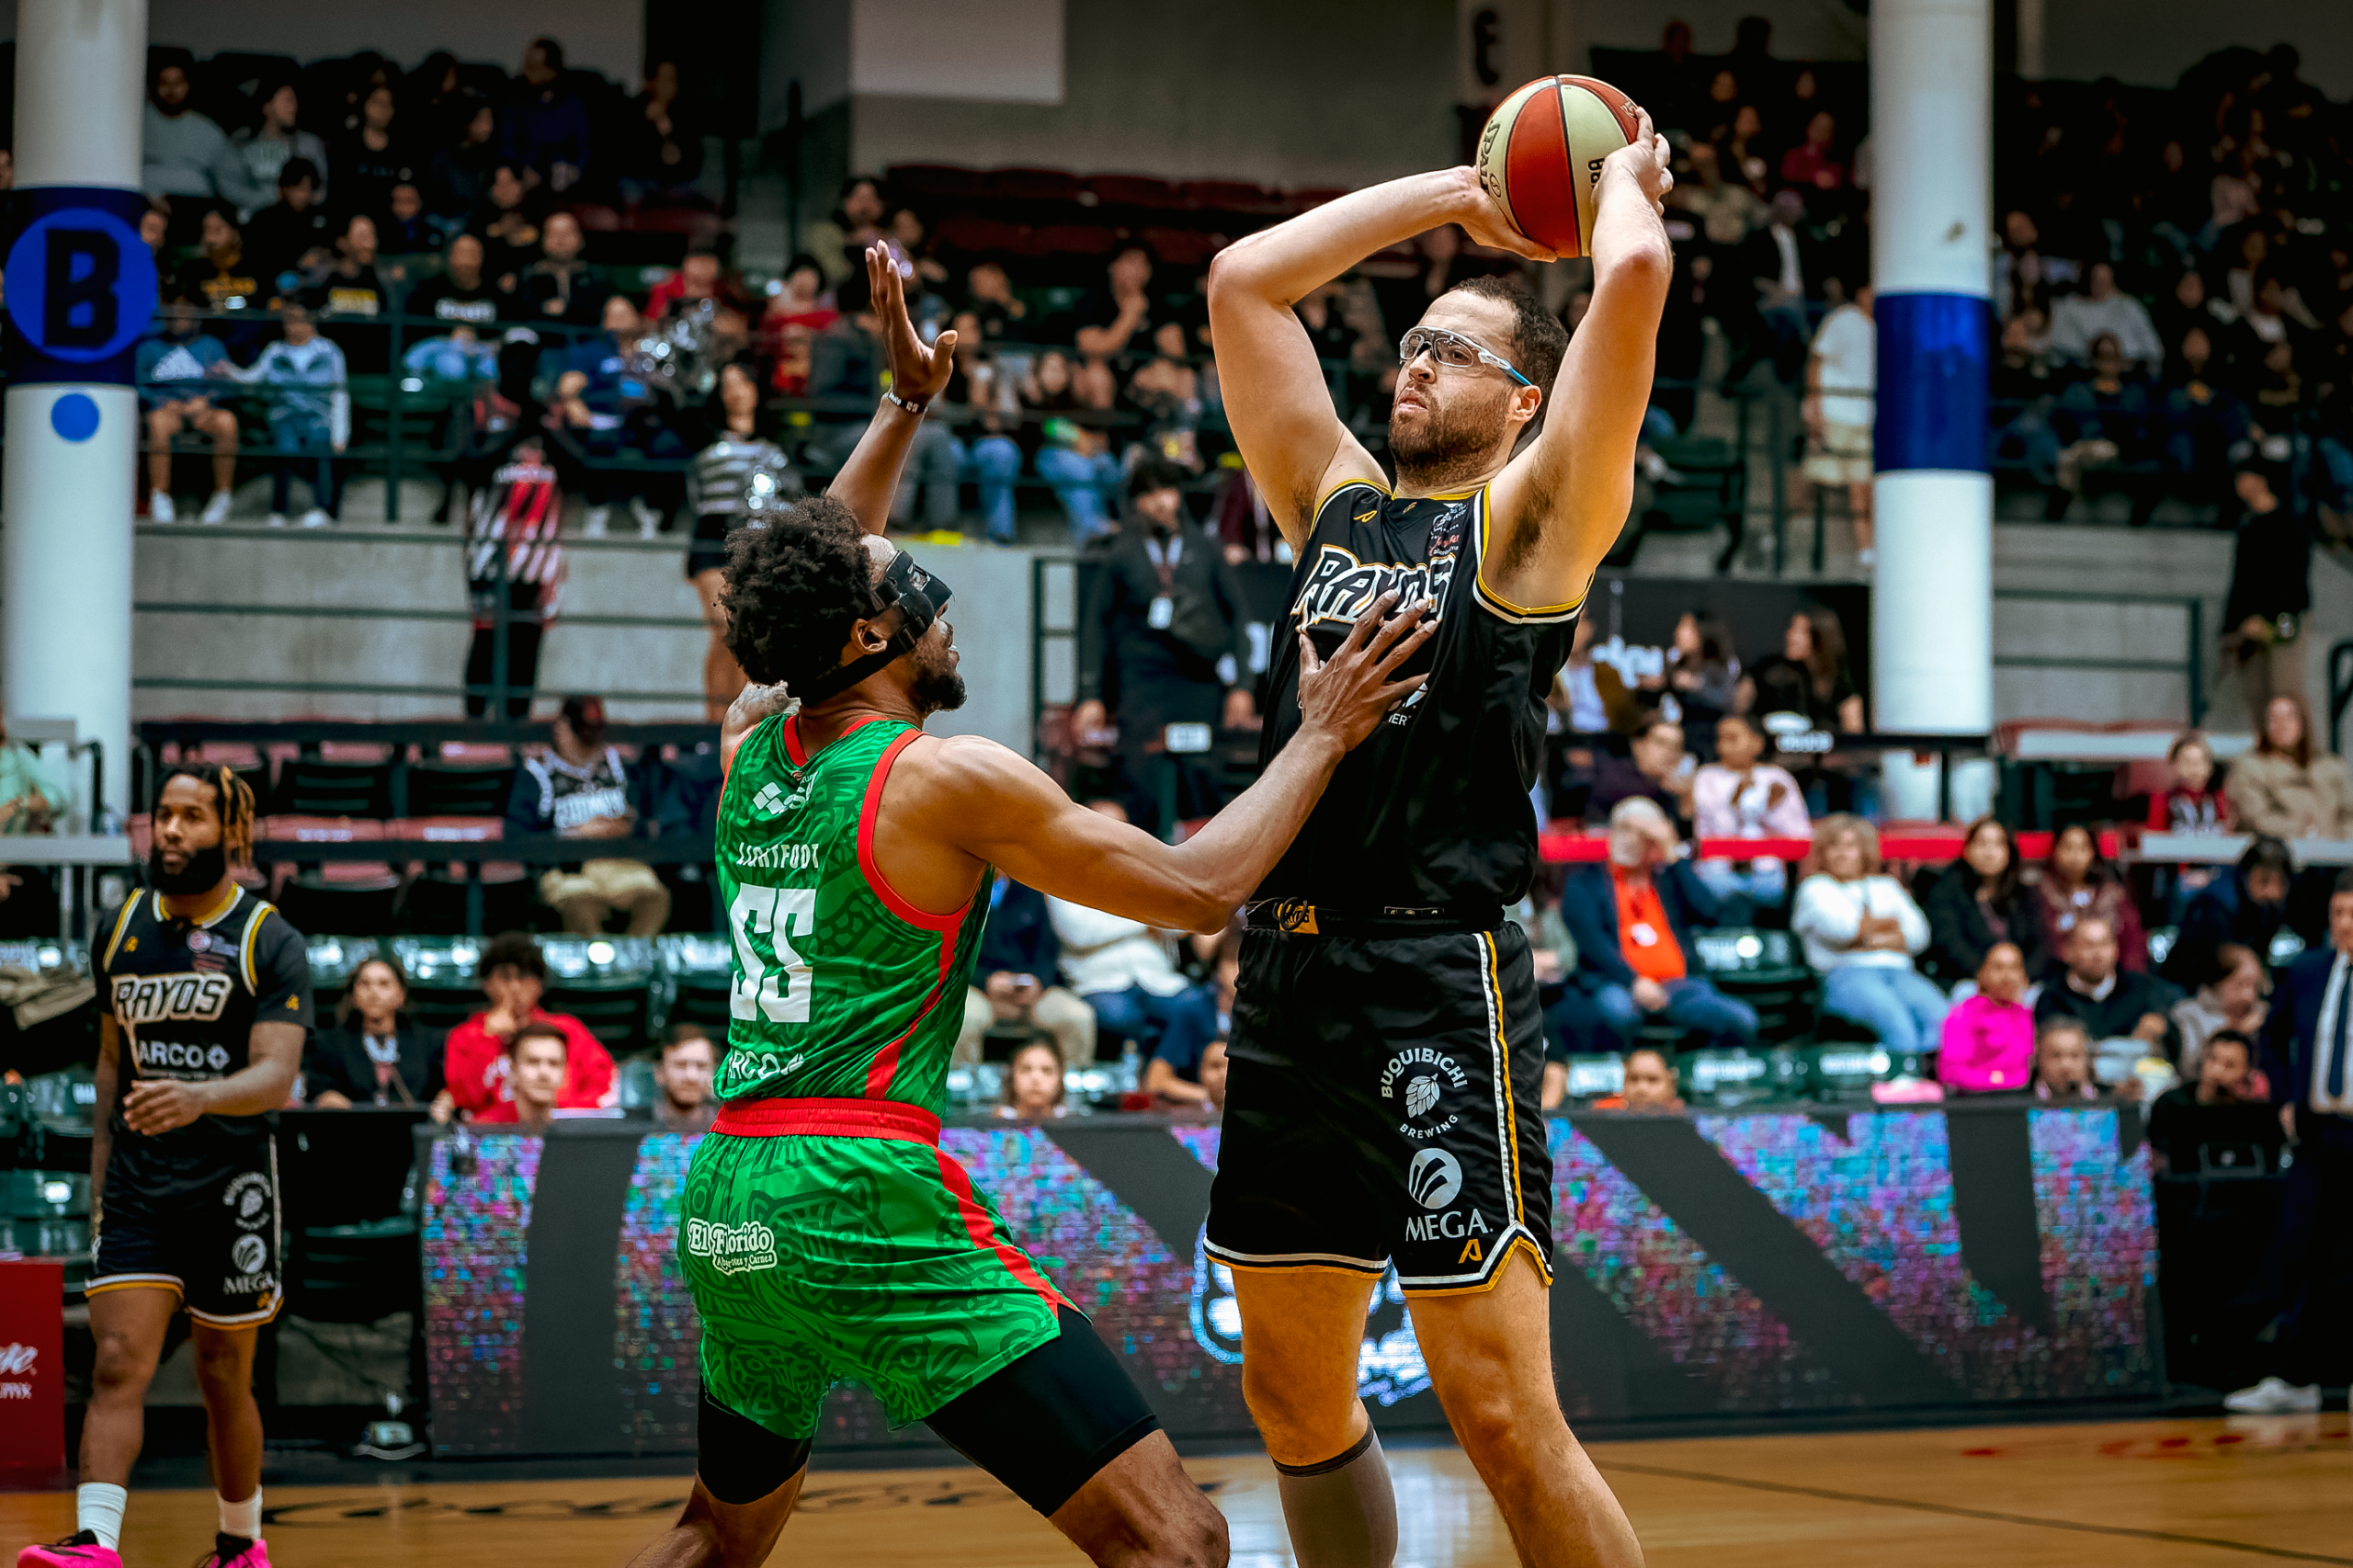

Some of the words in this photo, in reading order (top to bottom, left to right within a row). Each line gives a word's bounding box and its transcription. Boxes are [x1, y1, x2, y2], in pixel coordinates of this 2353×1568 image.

[44, 229, 119, 349] B
[1290, 544, 1457, 632] RAYOS
[729, 882, 816, 1023] 55
[111, 973, 233, 1026] RAYOS
[138, 1040, 204, 1069] ARCO
[1381, 1047, 1468, 1099] BUQUIBICHI
[1399, 1114, 1459, 1140] BREWING
[688, 1221, 709, 1252] El
[749, 1253, 773, 1265] Carnes
